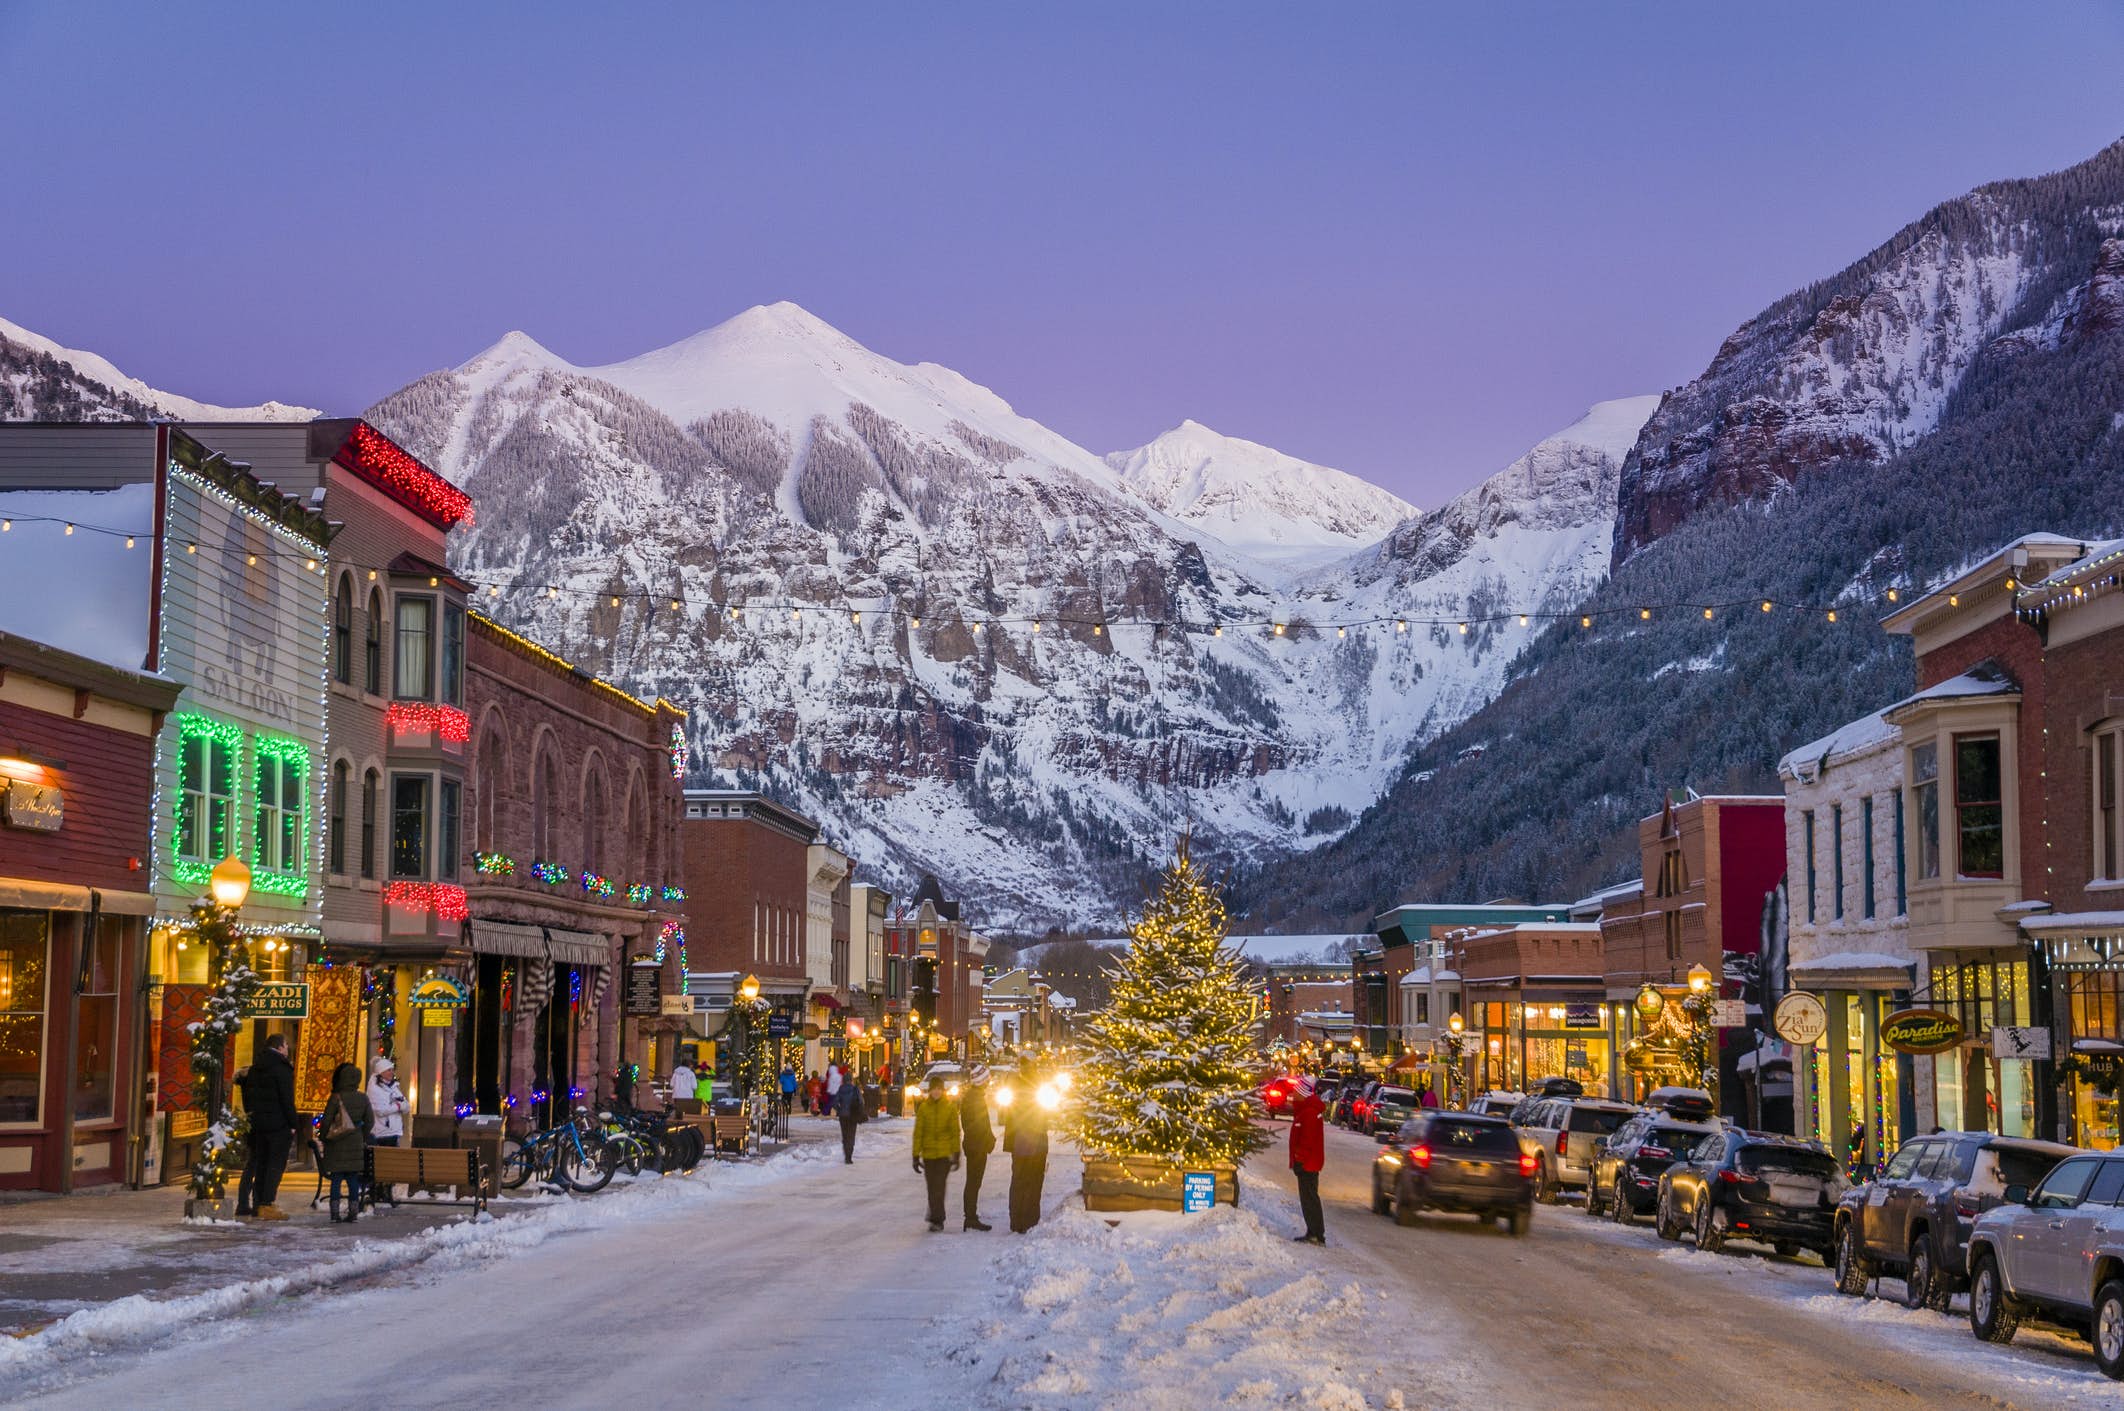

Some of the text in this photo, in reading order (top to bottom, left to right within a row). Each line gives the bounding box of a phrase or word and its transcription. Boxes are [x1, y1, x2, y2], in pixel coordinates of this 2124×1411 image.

[252, 987, 302, 998] ZADI
[247, 999, 302, 1009] NE RUGS
[1777, 1012, 1804, 1032] Zia
[1792, 1025, 1818, 1041] Sun
[1886, 1020, 1961, 1043] Paradise
[2087, 1062, 2114, 1072] HUB
[1192, 1191, 1206, 1199] ONLY
